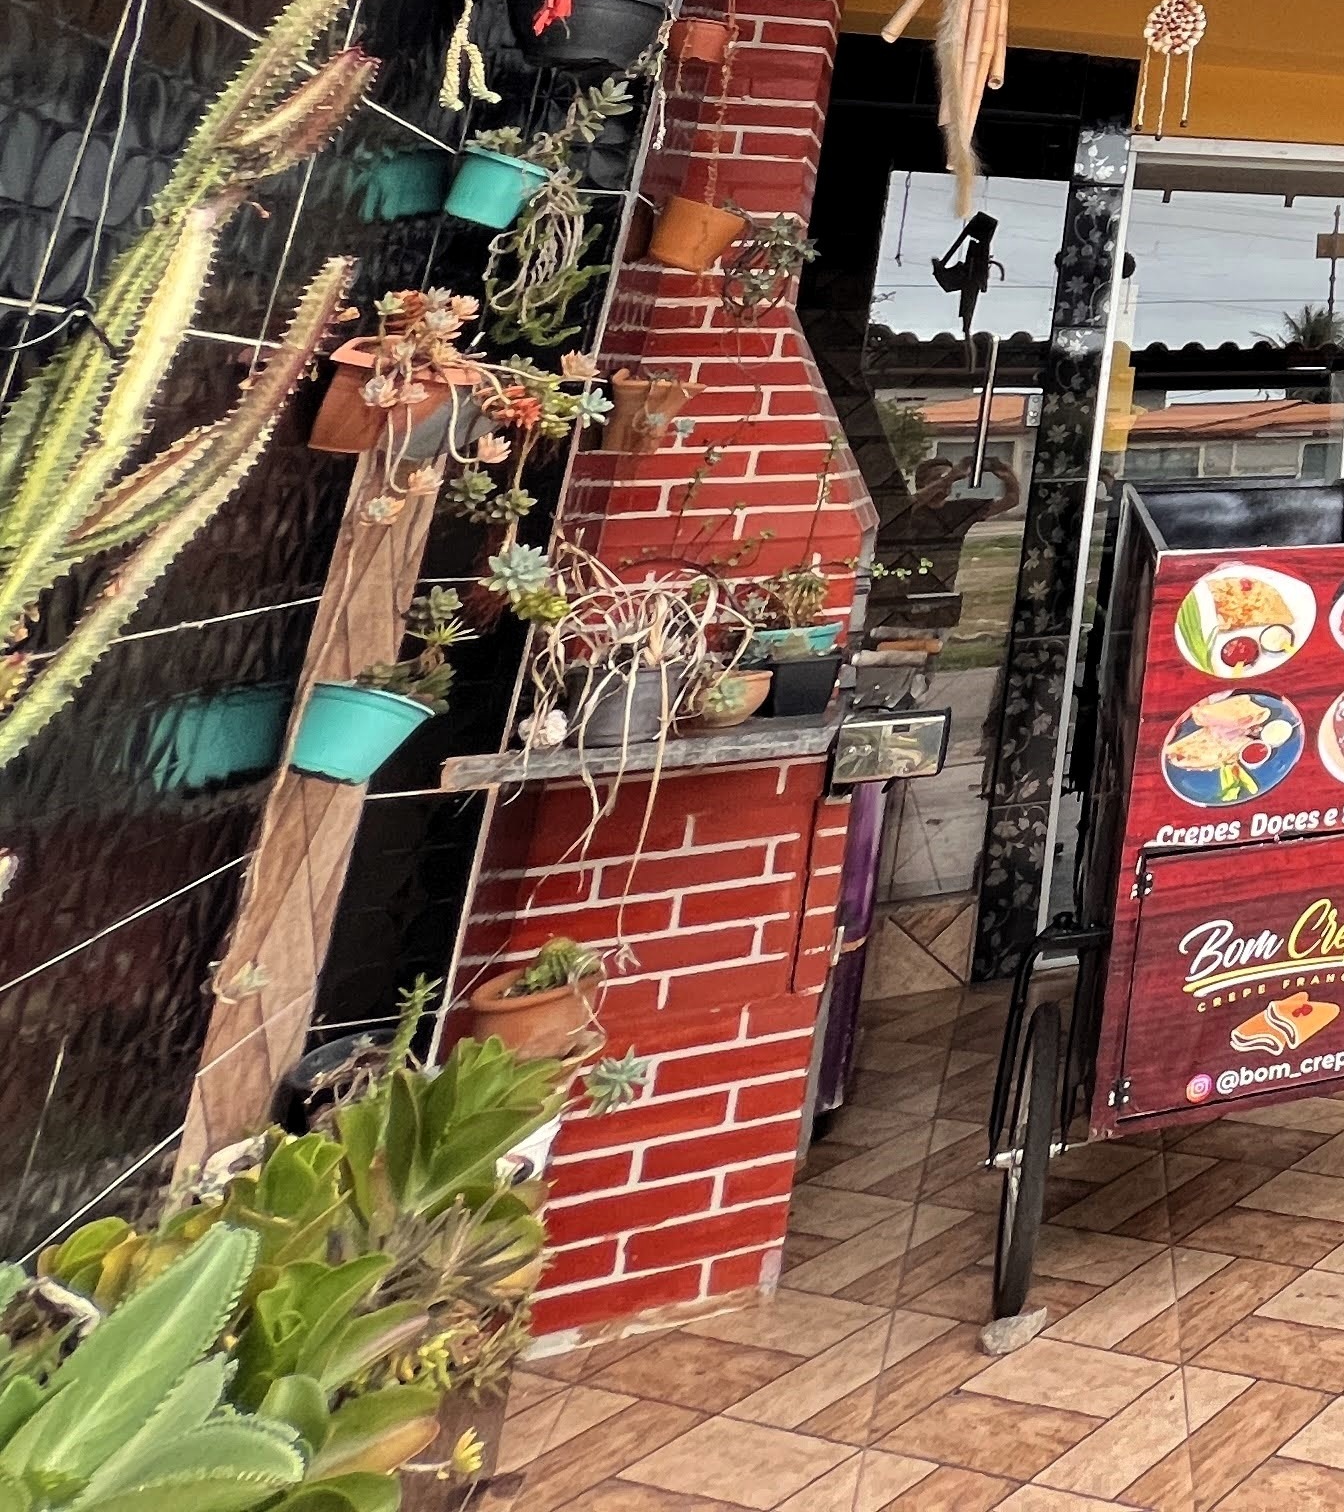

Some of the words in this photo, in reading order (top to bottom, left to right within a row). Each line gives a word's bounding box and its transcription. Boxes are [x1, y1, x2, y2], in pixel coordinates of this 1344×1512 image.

[1156, 819, 1241, 846] Crepes
[1250, 809, 1321, 837] Doces
[1323, 806, 1338, 827] e
[1178, 919, 1285, 982] Bom
[1196, 983, 1267, 1013] CREPE
